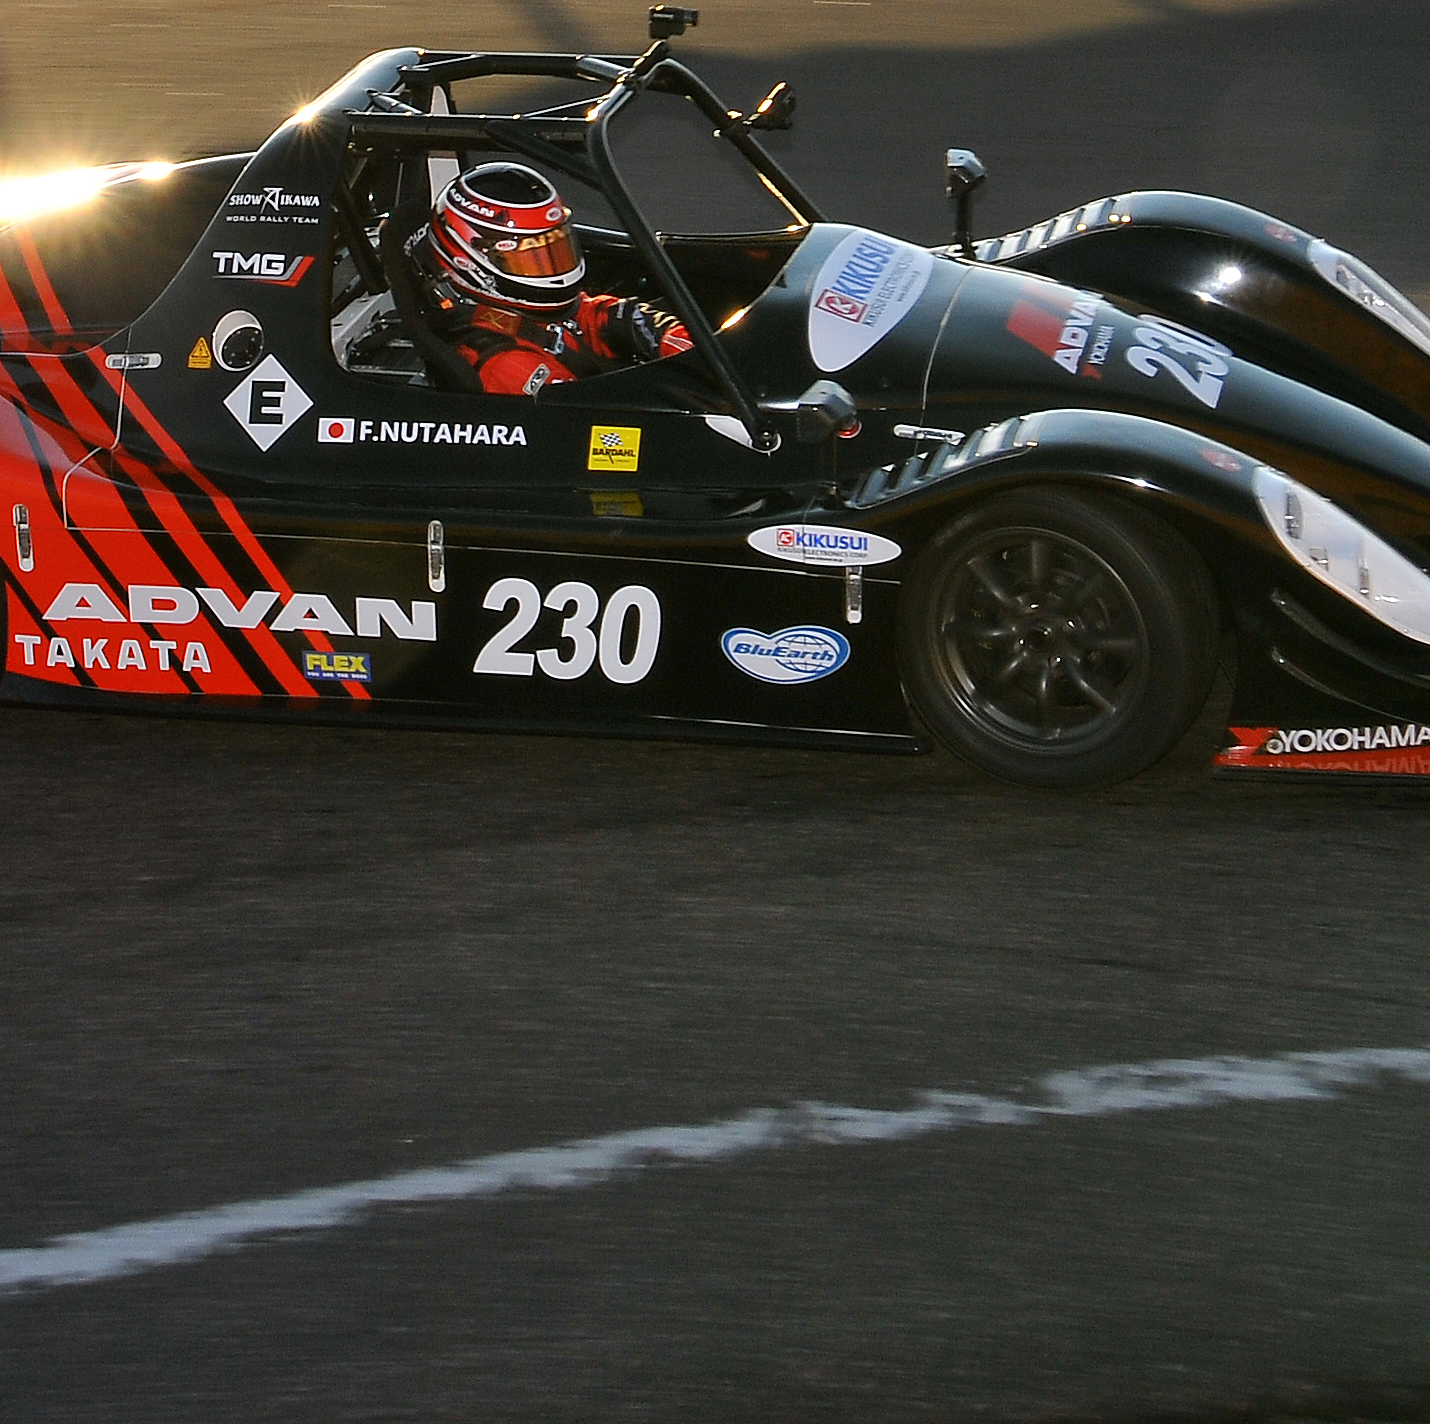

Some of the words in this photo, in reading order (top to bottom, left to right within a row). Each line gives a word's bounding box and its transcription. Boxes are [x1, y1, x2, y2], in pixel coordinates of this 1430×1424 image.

[229, 194, 263, 206] SHOW
[450, 188, 495, 218] ADVAN
[212, 251, 285, 275] TMG
[248, 380, 286, 425] E
[359, 421, 527, 446] F.NUTAHARA
[592, 448, 636, 457] BARDAHL
[796, 532, 868, 551] KIKUSUI
[41, 582, 438, 642] ADVAN
[473, 578, 661, 684] 230
[14, 635, 211, 673] TAKATA
[306, 654, 367, 673] FLEX
[734, 643, 834, 661] BluEarth
